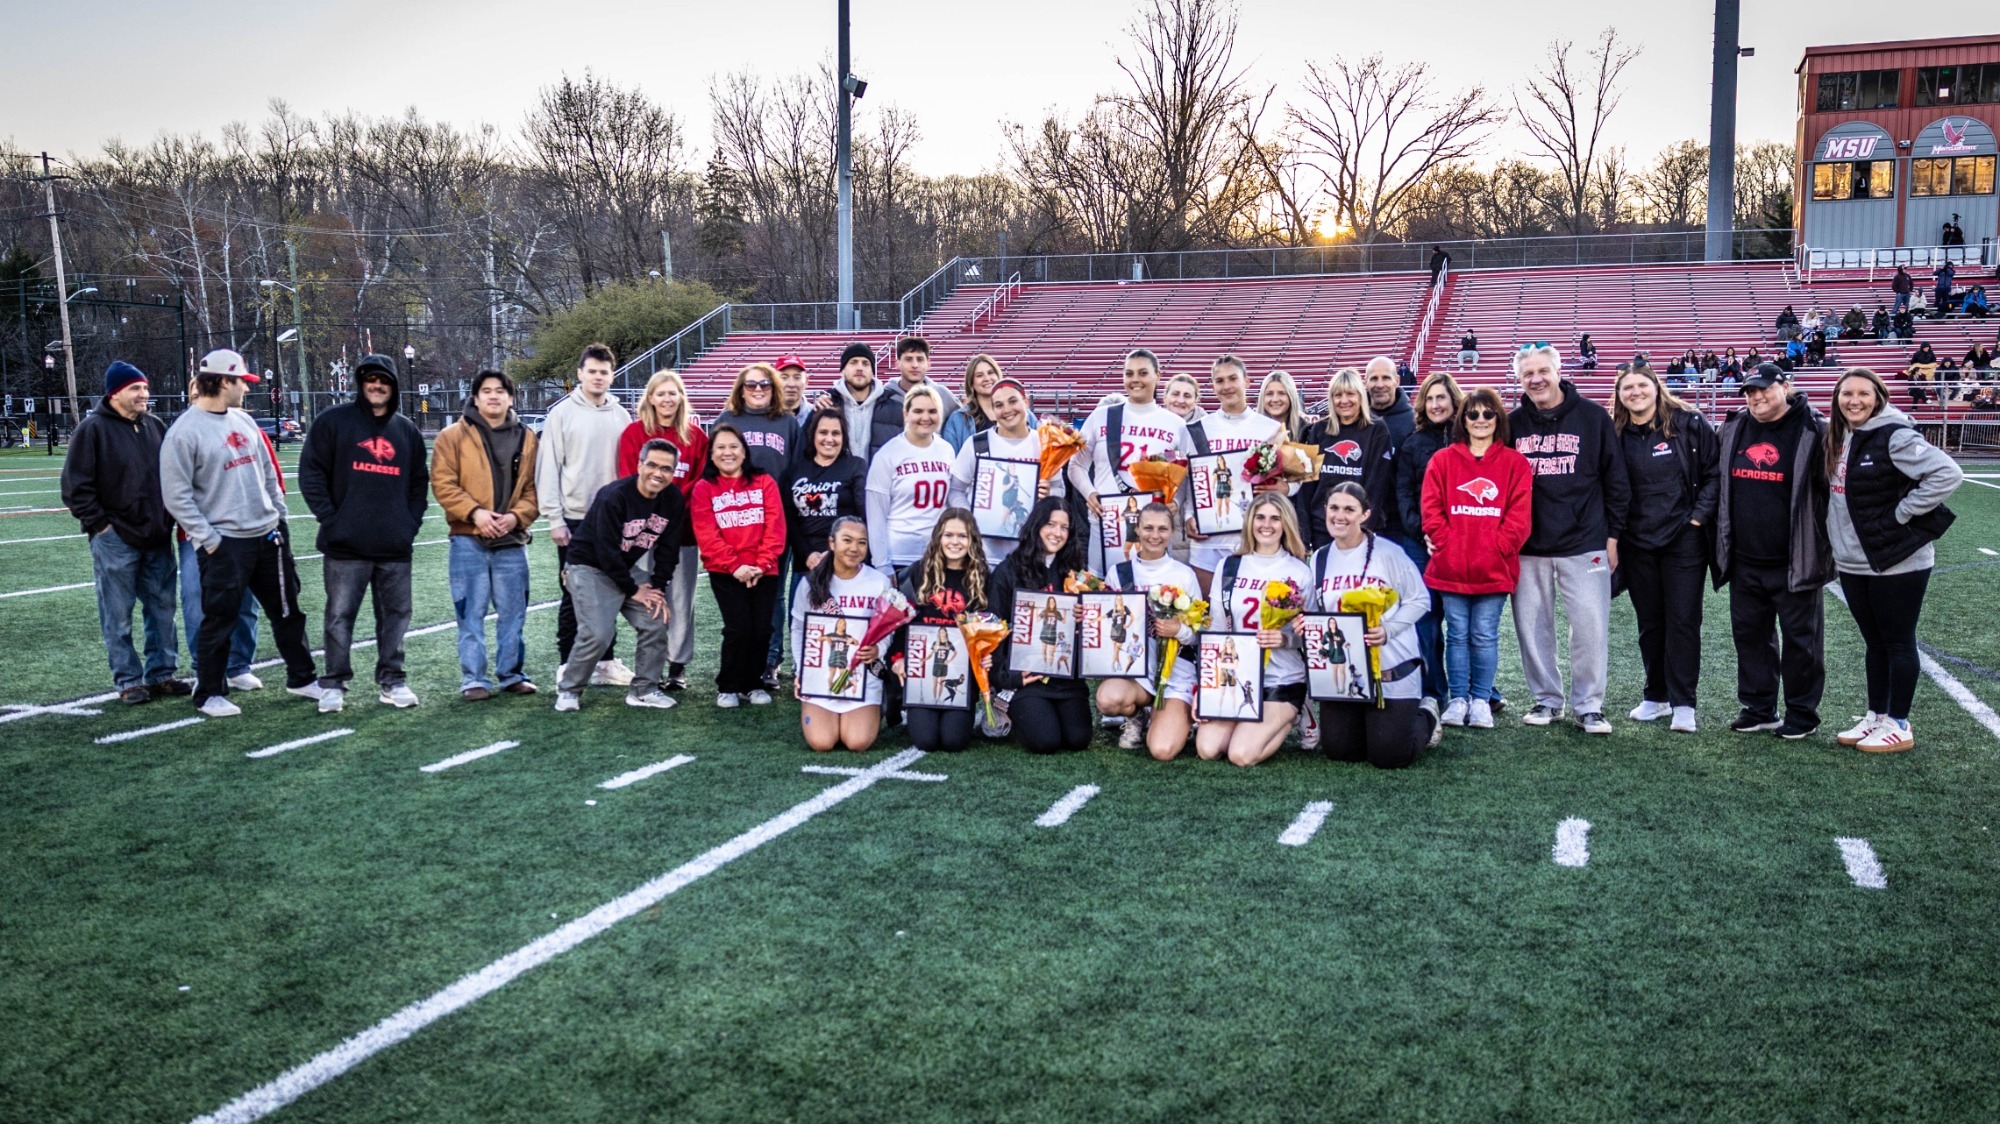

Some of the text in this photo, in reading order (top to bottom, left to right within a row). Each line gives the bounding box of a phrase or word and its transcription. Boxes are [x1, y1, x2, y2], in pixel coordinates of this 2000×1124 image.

[1822, 136, 1882, 160] MSU
[1129, 425, 1174, 443] HAWKS
[1556, 433, 1580, 455] STATE
[1207, 439, 1223, 452] ED
[352, 461, 401, 477] LACROSSE
[896, 462, 919, 477] RED
[1732, 468, 1784, 482] LACROSSE
[791, 477, 842, 497] Senior
[913, 480, 947, 509] 00
[975, 472, 993, 509] 2026
[1192, 471, 1211, 508] 2026
[1451, 505, 1502, 517] LACROSSE
[1102, 511, 1119, 547] 2026
[1233, 577, 1248, 589] ED
[838, 595, 876, 609] HAWK
[1082, 609, 1099, 648] 2026
[804, 629, 823, 667] 2026
[907, 640, 924, 678] 2026
[1200, 649, 1217, 688] 2026
